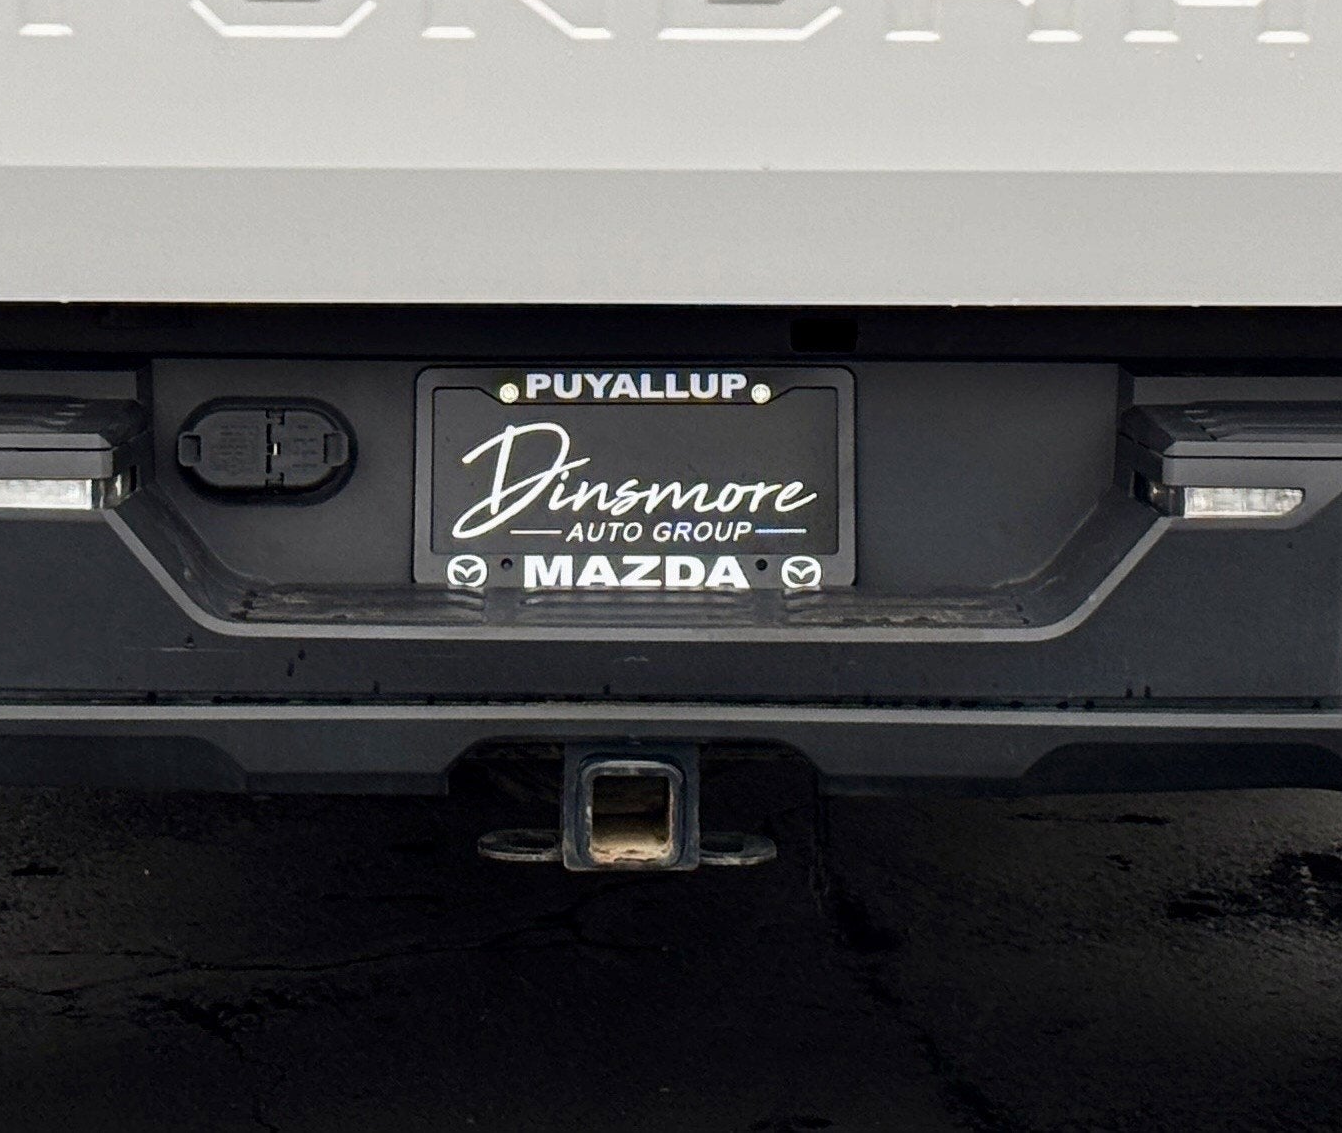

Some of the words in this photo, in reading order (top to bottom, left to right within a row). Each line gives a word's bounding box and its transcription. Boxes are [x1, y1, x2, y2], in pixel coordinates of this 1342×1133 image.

[525, 373, 748, 399] PUYALLUP
[452, 422, 817, 539] Dinsmore
[565, 522, 643, 542] AUTO
[652, 521, 753, 542] GROUP
[524, 555, 751, 589] MAZDA
